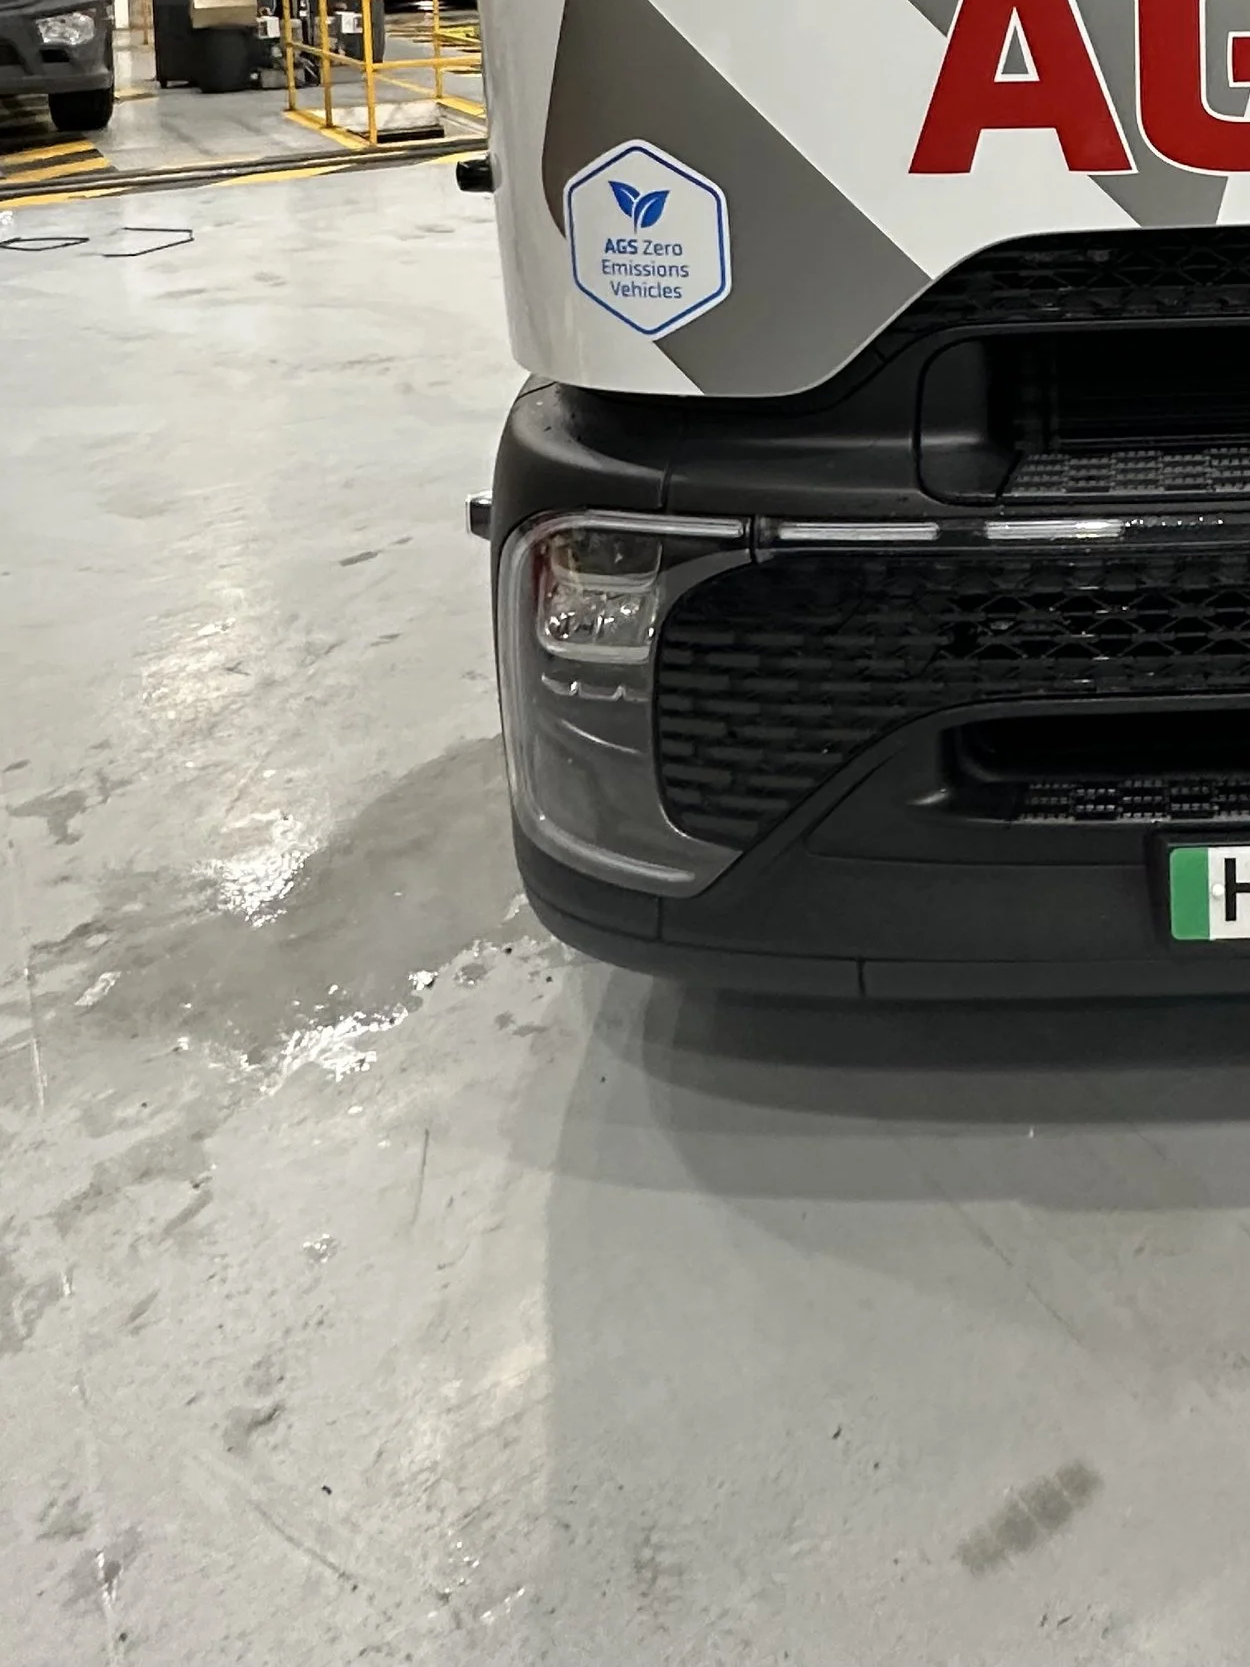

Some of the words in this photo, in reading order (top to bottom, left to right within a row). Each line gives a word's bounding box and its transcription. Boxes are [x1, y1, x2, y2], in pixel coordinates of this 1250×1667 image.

[604, 238, 638, 255] AGS
[643, 240, 683, 256] Zero
[602, 259, 689, 278] Emissions
[610, 281, 682, 299] Vehicles
